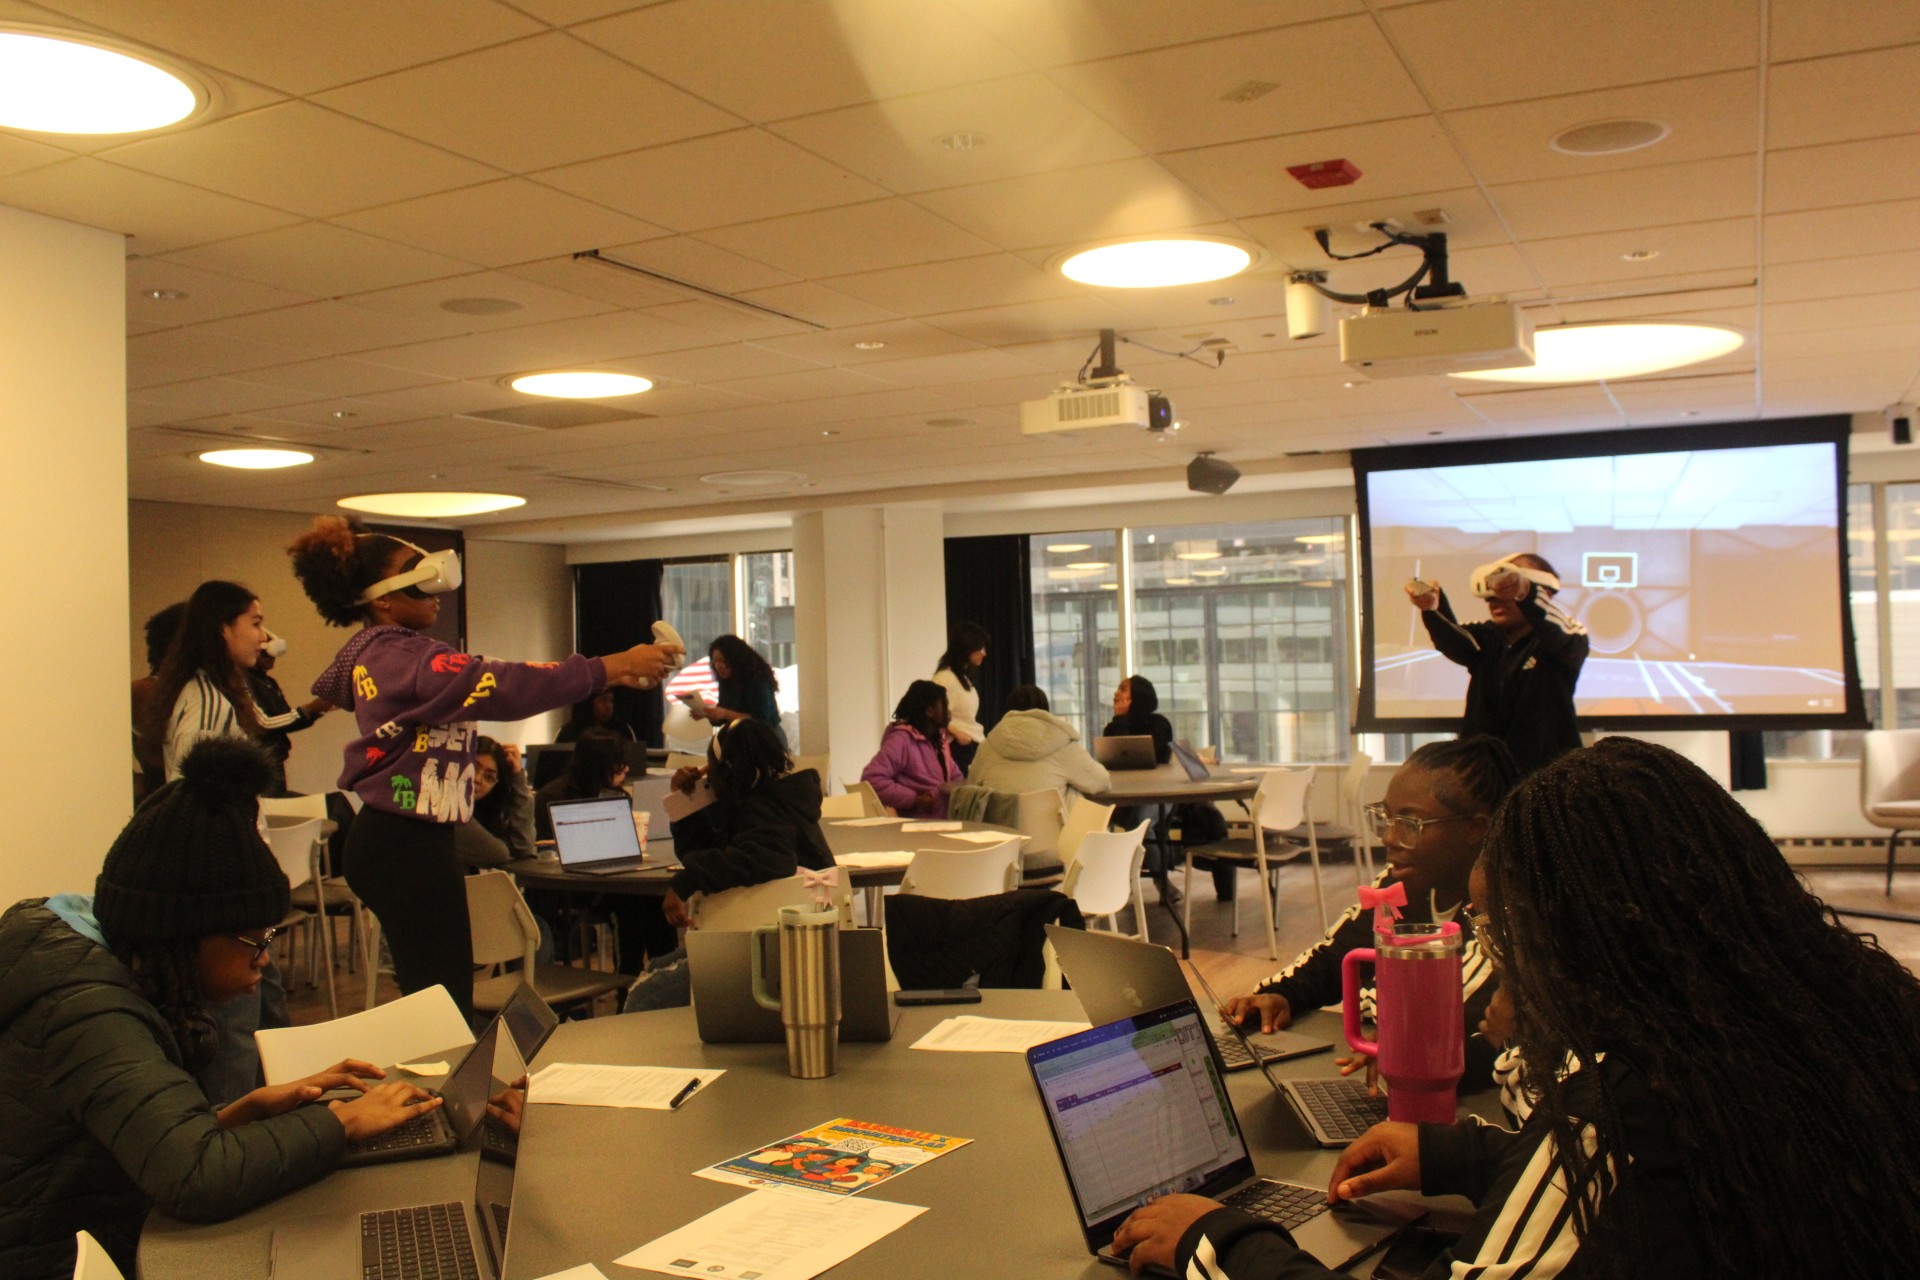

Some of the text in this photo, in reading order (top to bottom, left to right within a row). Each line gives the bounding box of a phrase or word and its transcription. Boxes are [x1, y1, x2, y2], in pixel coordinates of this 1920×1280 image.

[828, 1125, 917, 1144] INNOVATION
[913, 1140, 948, 1149] LAB
[843, 1120, 935, 1141] BASEBALL
